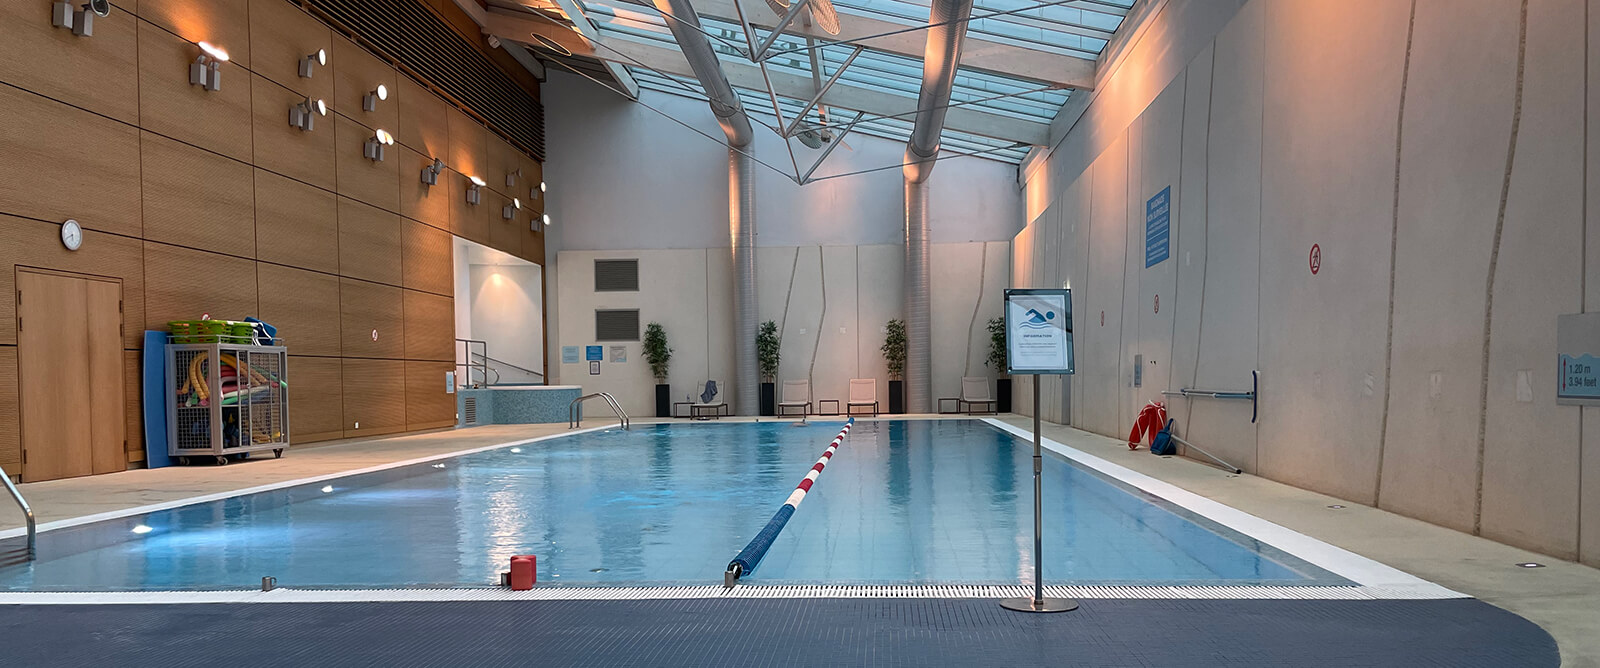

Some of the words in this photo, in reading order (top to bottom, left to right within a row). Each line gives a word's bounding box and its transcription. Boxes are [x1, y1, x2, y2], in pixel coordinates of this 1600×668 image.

[1569, 363, 1583, 374] 1.20
[1584, 366, 1591, 374] m
[1569, 376, 1582, 387] 3.94
[1584, 376, 1597, 387] feet
